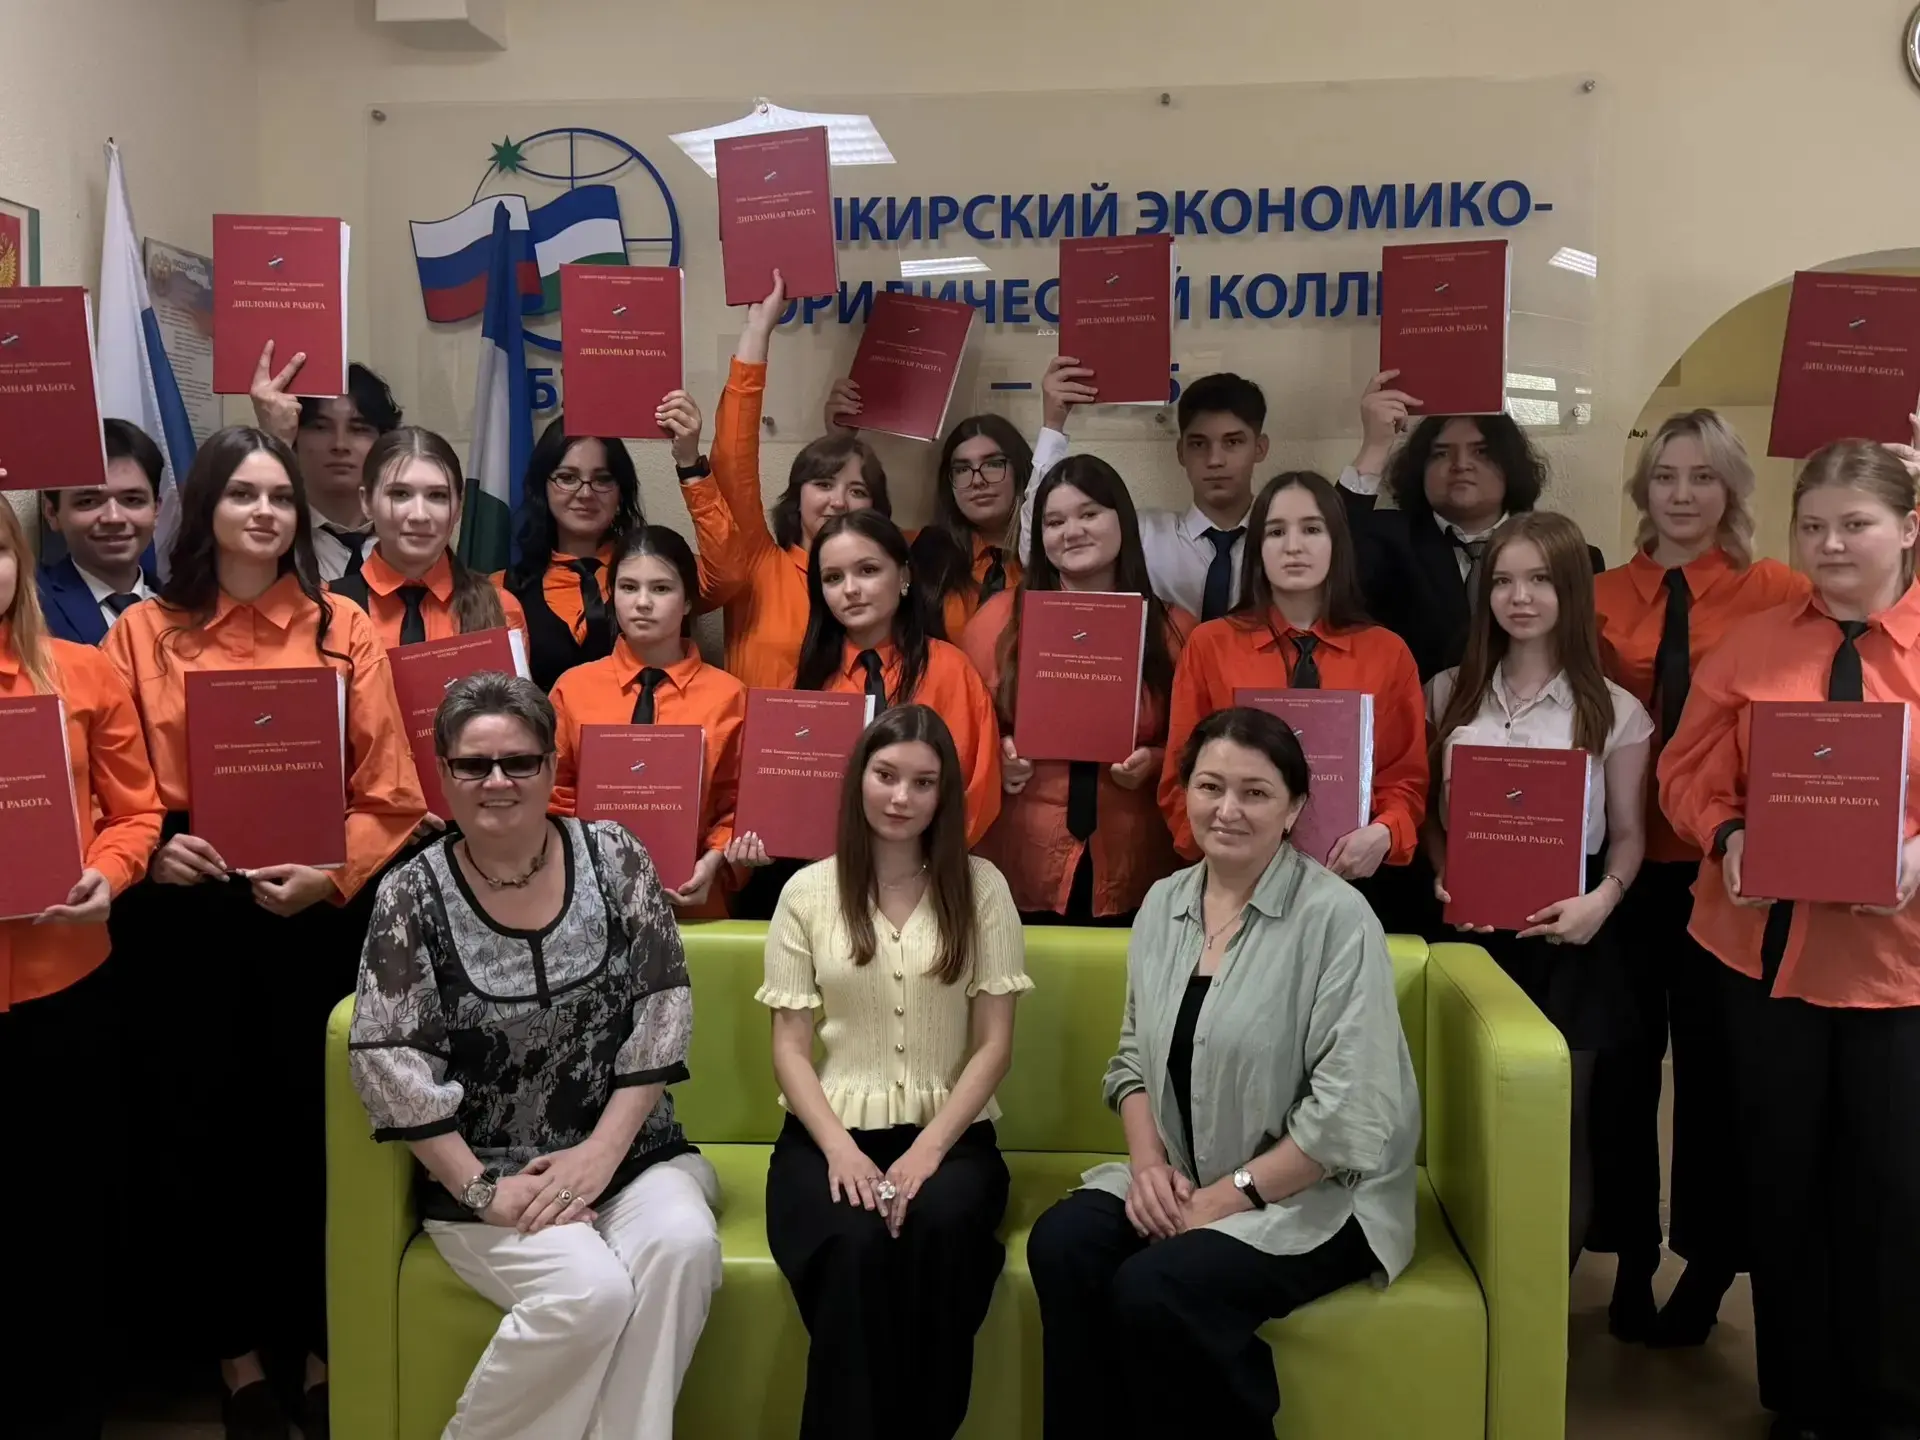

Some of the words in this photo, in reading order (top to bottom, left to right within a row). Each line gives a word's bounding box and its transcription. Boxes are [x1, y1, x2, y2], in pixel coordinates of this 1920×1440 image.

[787, 208, 816, 218] РАБОТА
[834, 182, 1117, 241] КИРСКИЙ
[1136, 178, 1553, 235] ЭКОНОМИКО-
[292, 301, 326, 310] РАБОТА
[1456, 324, 1488, 332] РАБОТА
[636, 348, 667, 357] РАБОТА
[36, 383, 76, 392] РАБОТА
[1091, 673, 1122, 682] РАБОТА
[214, 763, 282, 776] ДИПЛОМНАЯ
[285, 761, 324, 771] РАБОТА
[757, 767, 811, 777] ДИПЛОМНАЯ
[1311, 773, 1344, 782] РАБОТА
[7, 797, 52, 809] РАБОТА
[1768, 793, 1837, 805] ДИПЛОМНАЯ
[1839, 796, 1880, 806] РАБОТА
[594, 803, 649, 811] ДИПЛОМНАЯ
[650, 803, 682, 811] РАБОТА
[1466, 831, 1527, 843] ДИПЛОМНАЯ
[1529, 835, 1565, 846] РАБОТА
